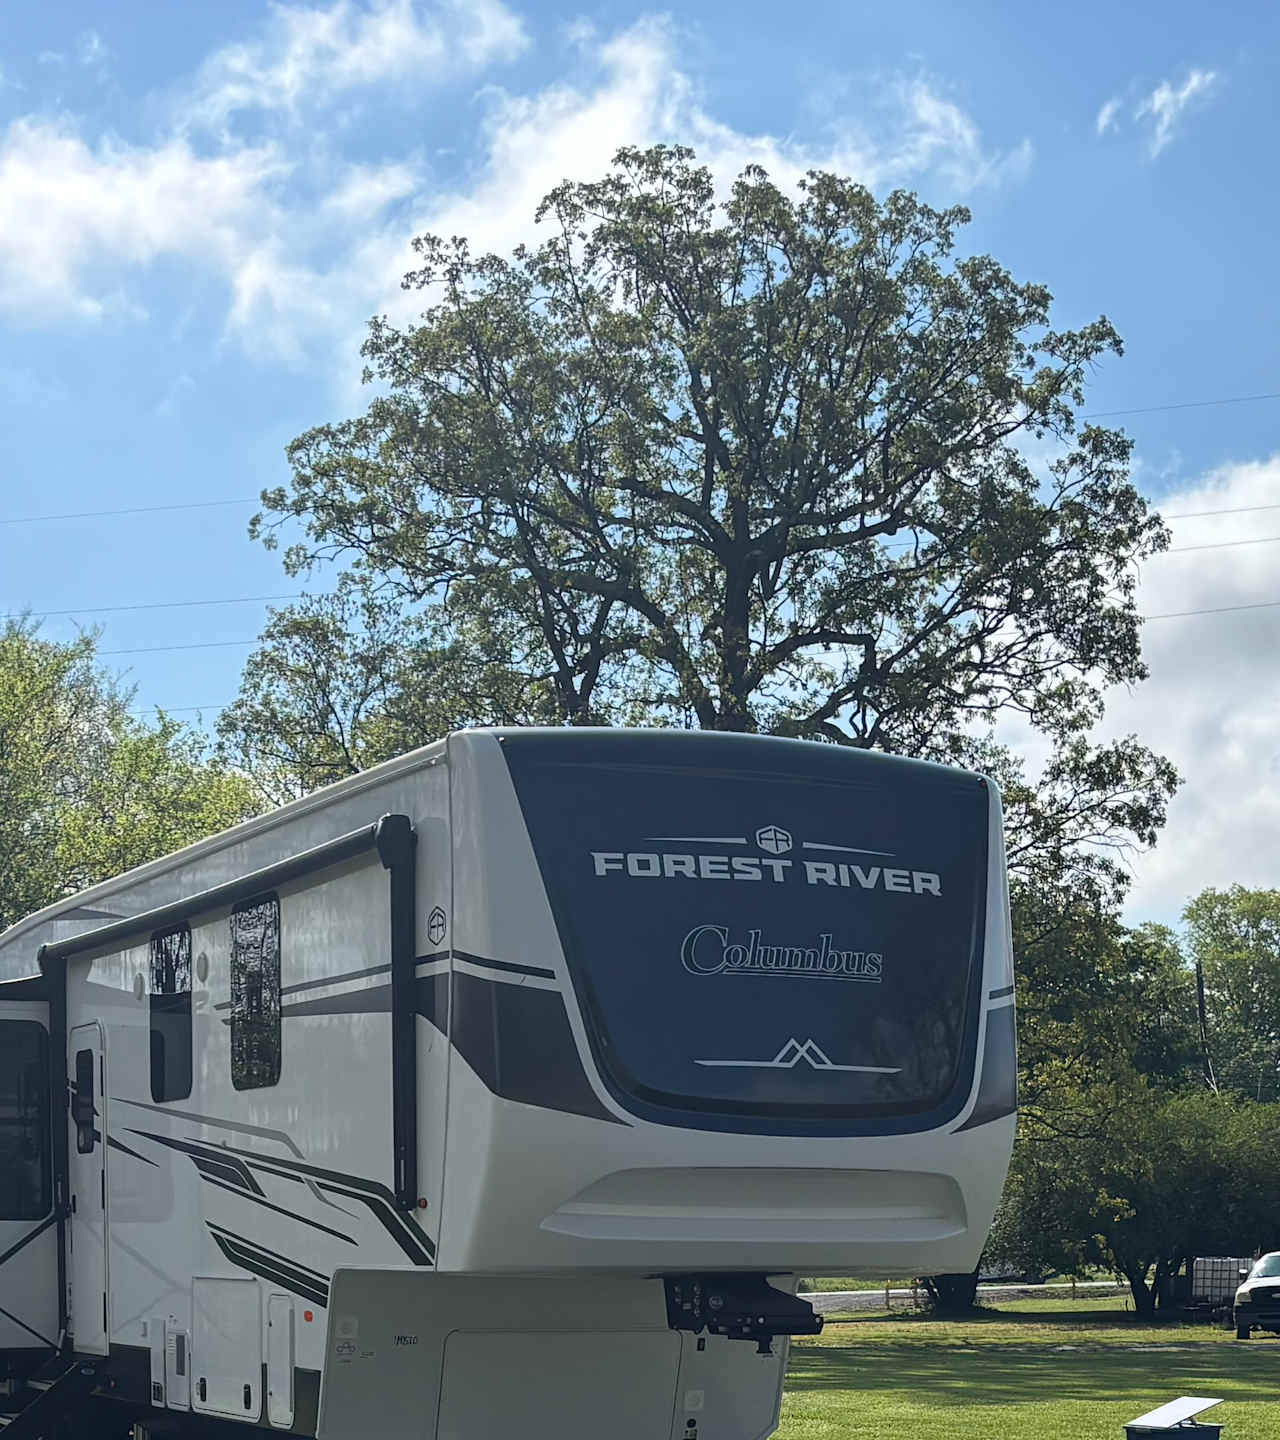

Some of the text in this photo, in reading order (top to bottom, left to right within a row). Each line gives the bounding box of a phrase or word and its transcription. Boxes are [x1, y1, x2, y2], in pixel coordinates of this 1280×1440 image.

[590, 851, 943, 897] FOREST RIVER
[680, 923, 883, 977] Columbus
